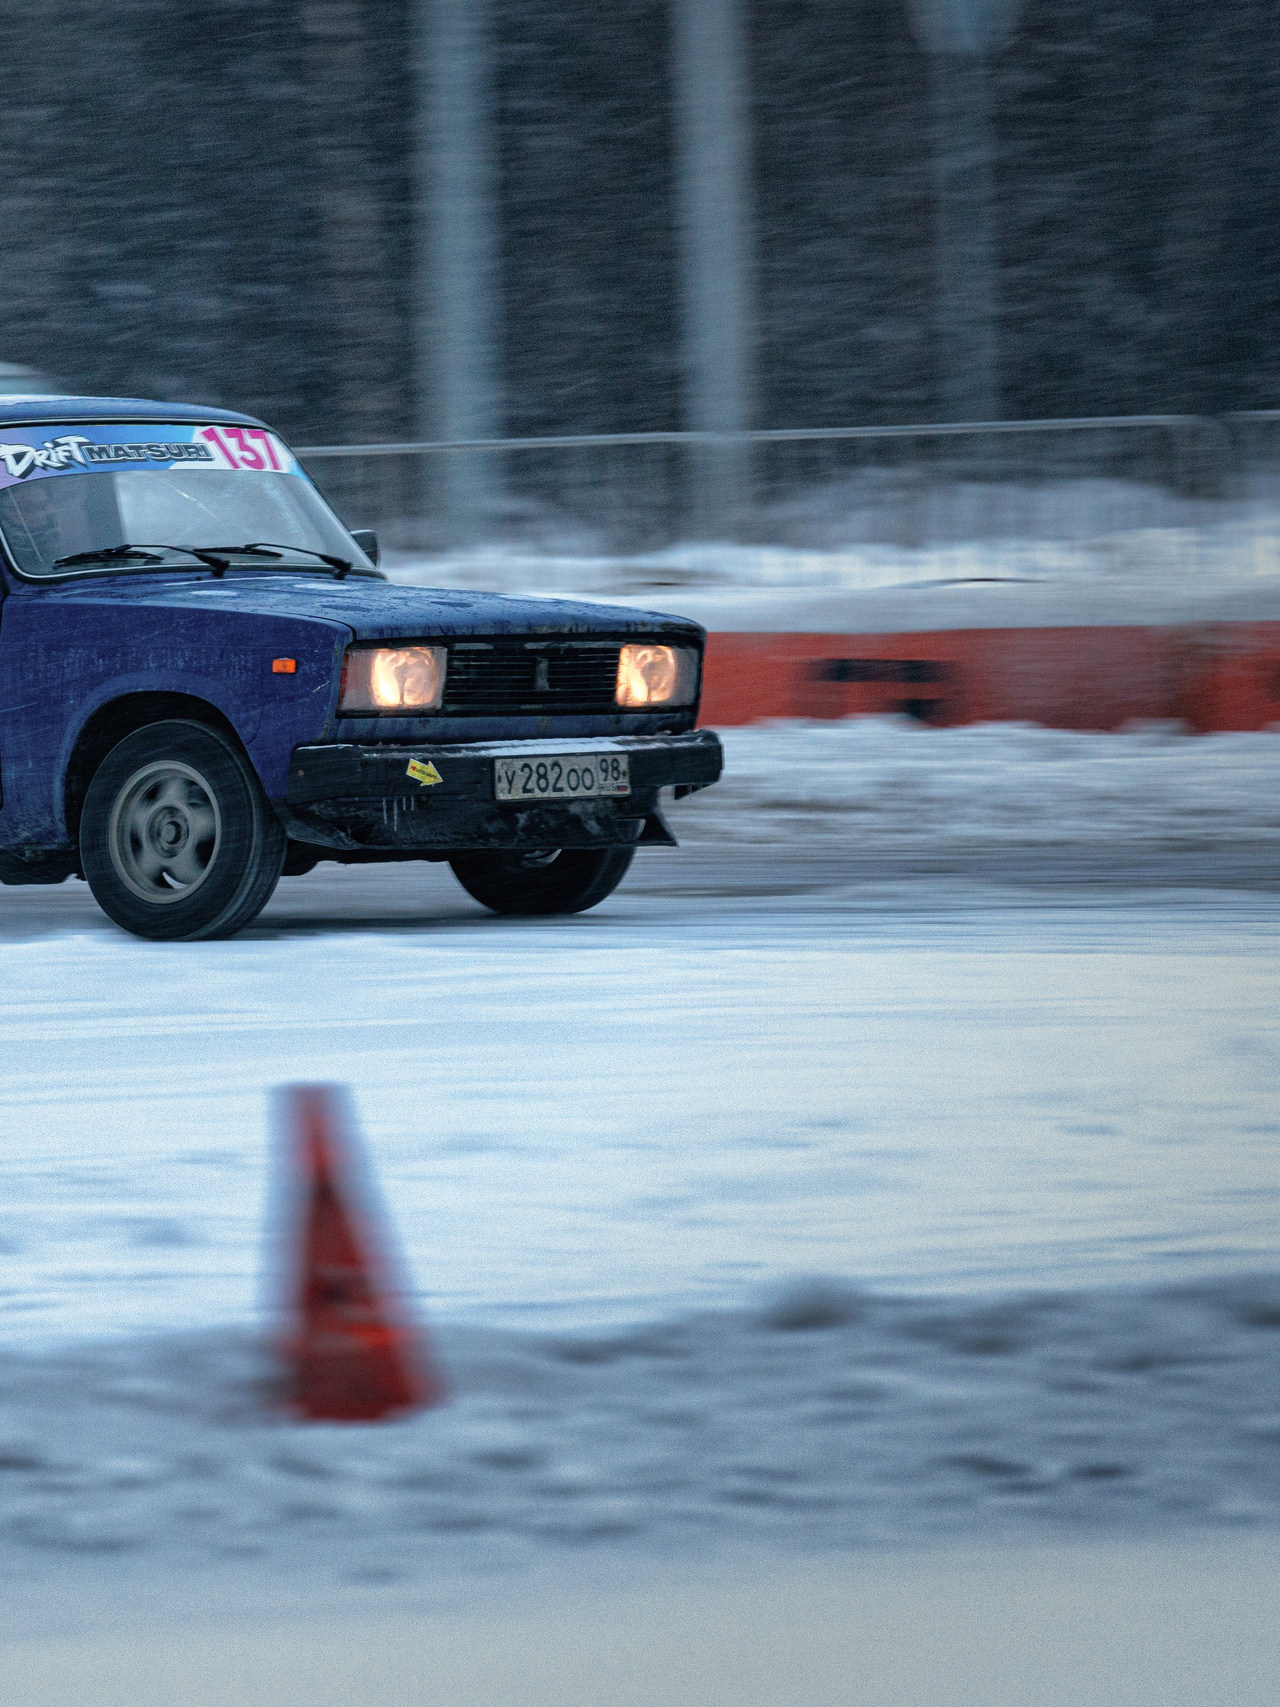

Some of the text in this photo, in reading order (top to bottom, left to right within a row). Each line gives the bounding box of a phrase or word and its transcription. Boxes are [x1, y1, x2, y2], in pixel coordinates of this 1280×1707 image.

[81, 442, 215, 463] MATSURI
[200, 427, 283, 471] 137
[600, 758, 620, 781] 98
